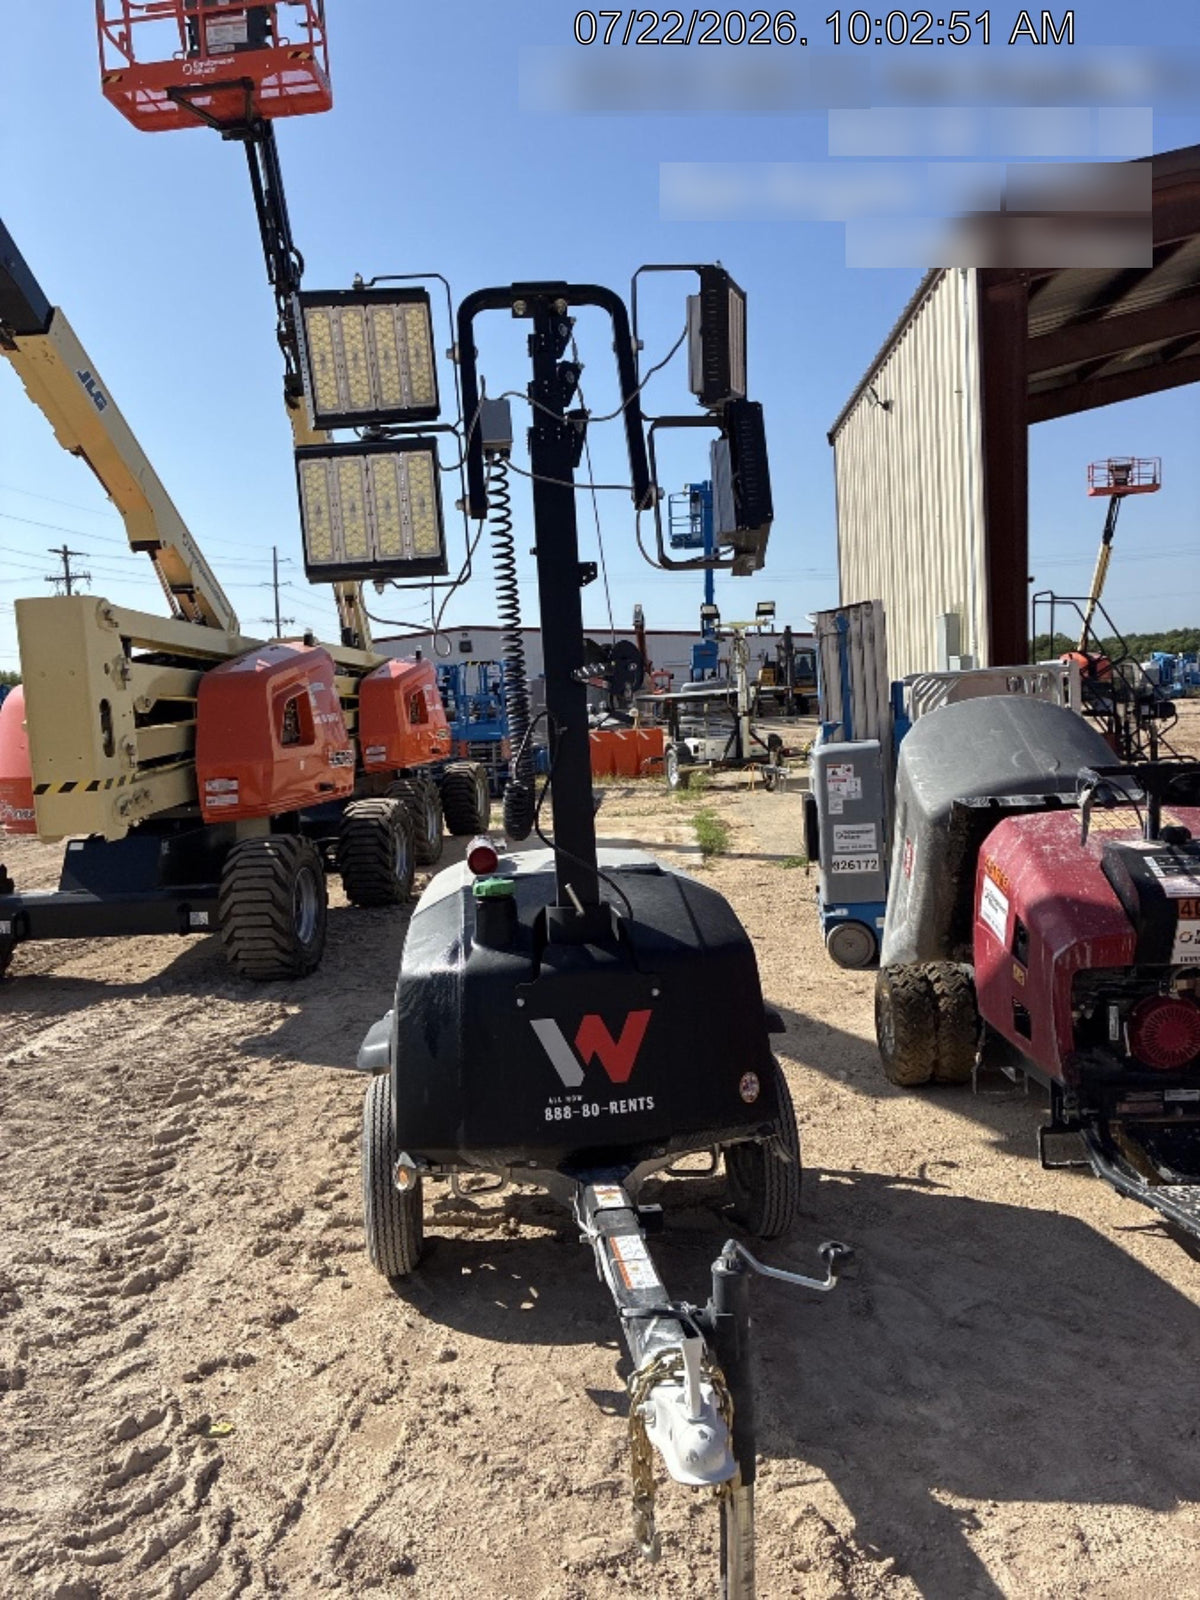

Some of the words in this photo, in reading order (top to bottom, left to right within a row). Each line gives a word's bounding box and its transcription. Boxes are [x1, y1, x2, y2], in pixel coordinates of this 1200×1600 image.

[76, 369, 108, 412] JLG
[1180, 901, 1200, 918] 4
[543, 1095, 656, 1122] 888-80-RENTS
